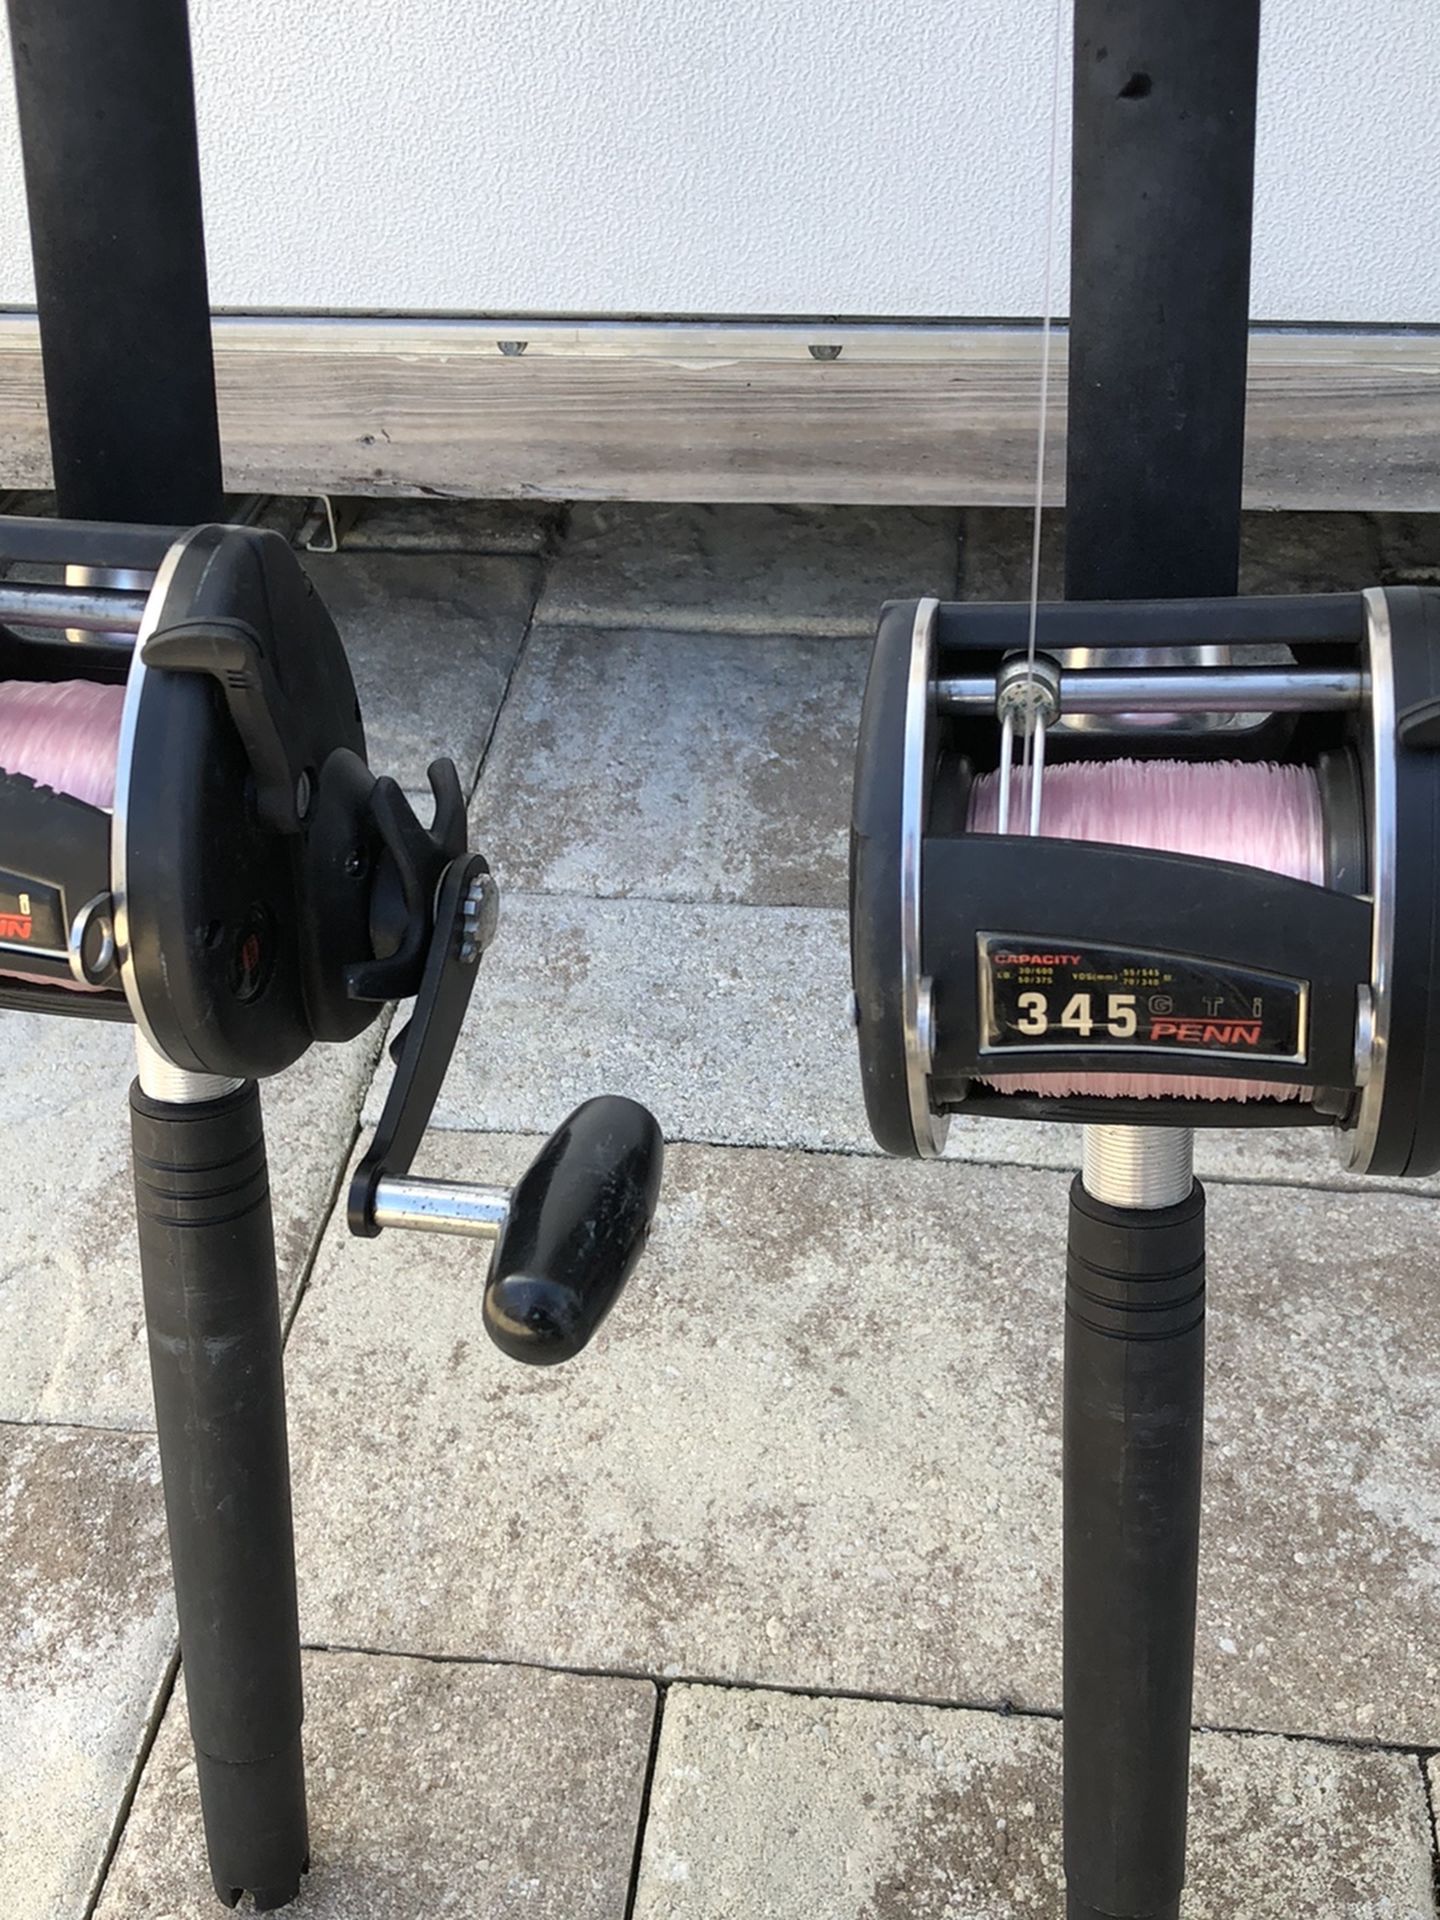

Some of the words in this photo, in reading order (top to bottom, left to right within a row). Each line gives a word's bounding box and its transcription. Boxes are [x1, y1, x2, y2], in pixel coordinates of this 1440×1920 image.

[994, 954, 1082, 966] CAPACITY
[1017, 992, 1137, 1038] 345
[1149, 1022, 1263, 1045] PENN
